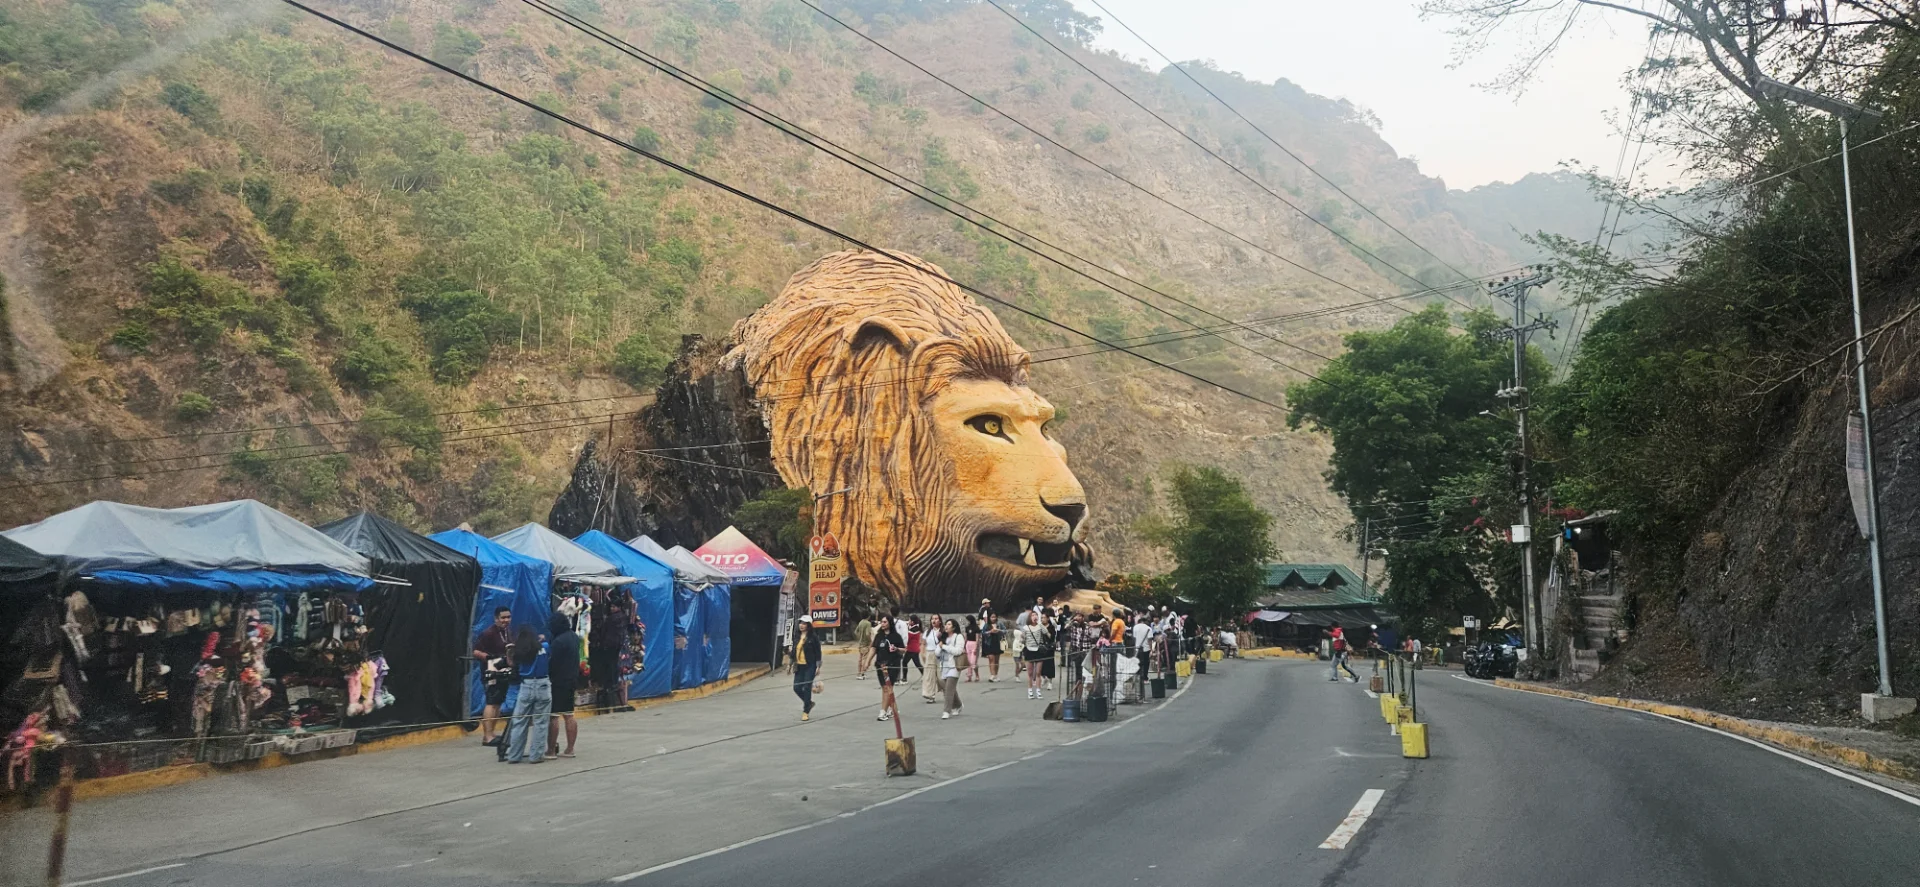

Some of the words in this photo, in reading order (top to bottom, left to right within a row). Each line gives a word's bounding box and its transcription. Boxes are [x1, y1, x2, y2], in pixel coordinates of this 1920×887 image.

[700, 554, 749, 564] DITO
[814, 563, 838, 571] LION'S
[815, 571, 836, 579] HEAD
[812, 610, 837, 619] DAVIES
